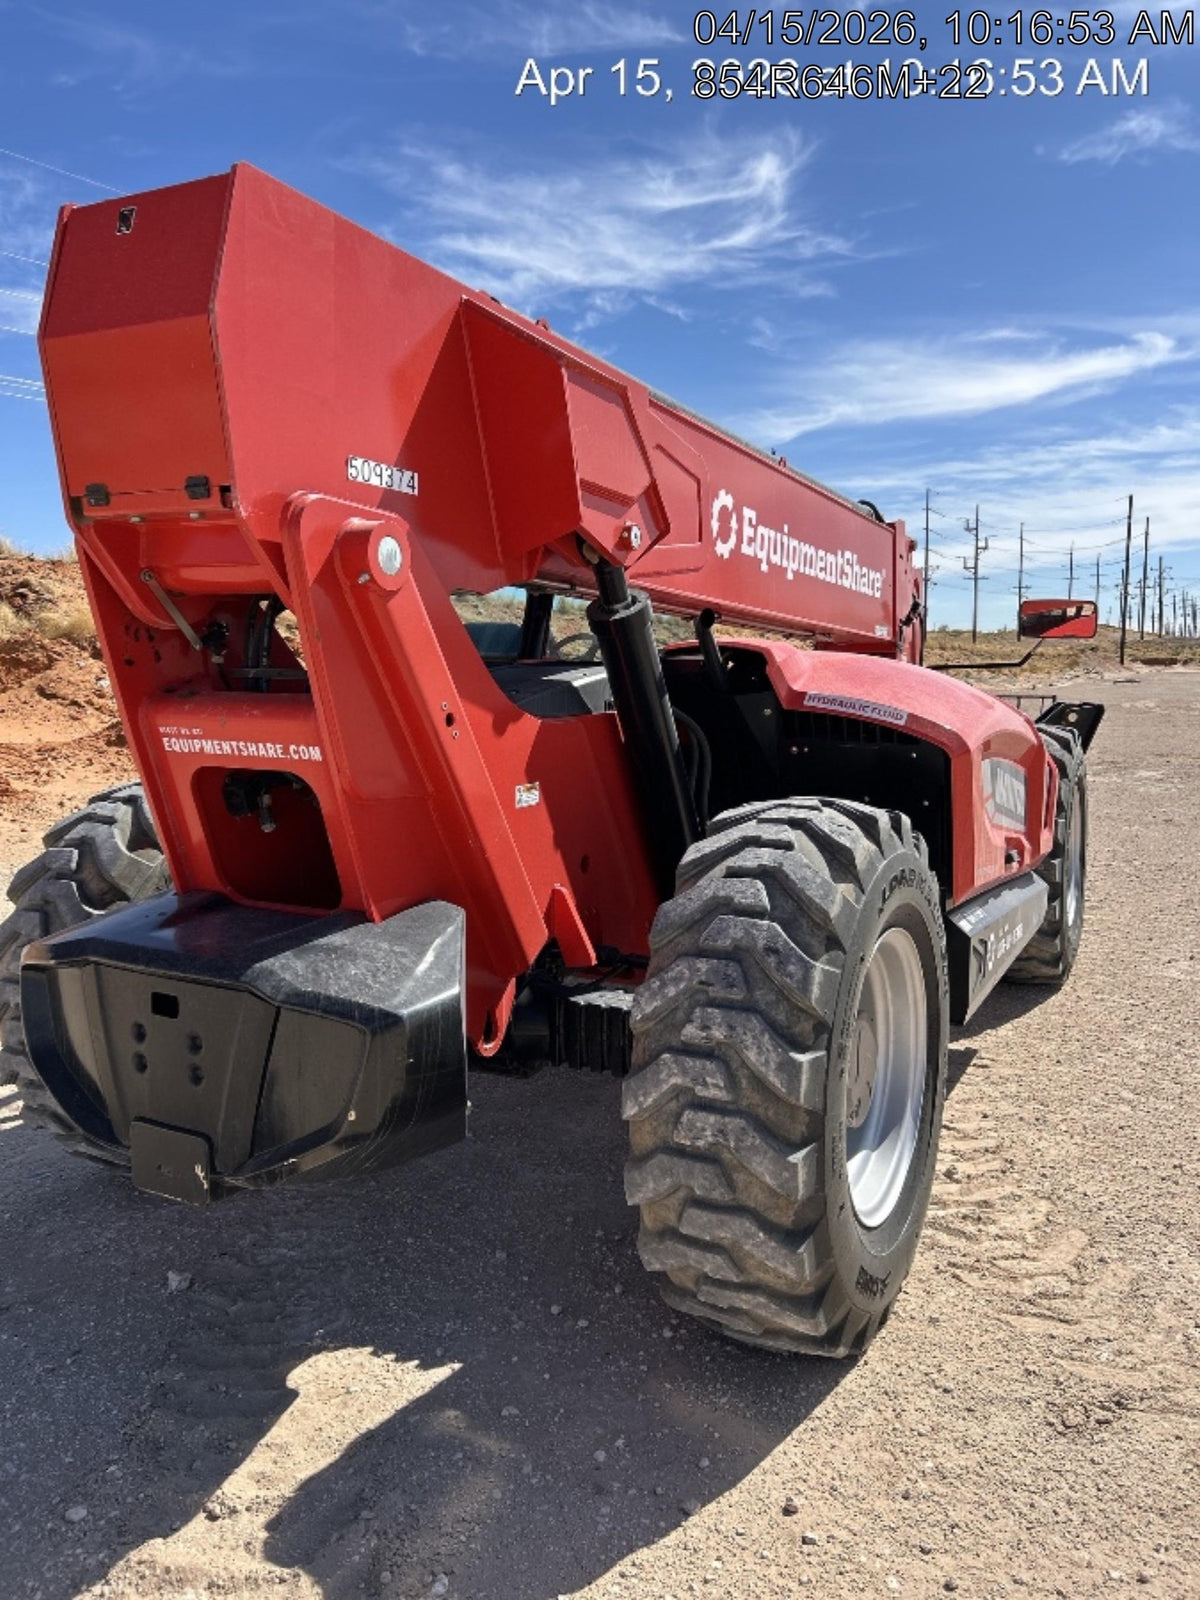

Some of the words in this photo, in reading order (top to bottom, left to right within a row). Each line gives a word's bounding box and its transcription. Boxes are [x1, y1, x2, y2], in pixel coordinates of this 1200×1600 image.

[348, 455, 418, 494] 509374
[740, 506, 883, 598] EquipmentShare
[806, 694, 870, 713] HYDRAULIC
[871, 706, 905, 722] FLUID
[161, 737, 323, 762] EQUIPMENTSHARE.COM
